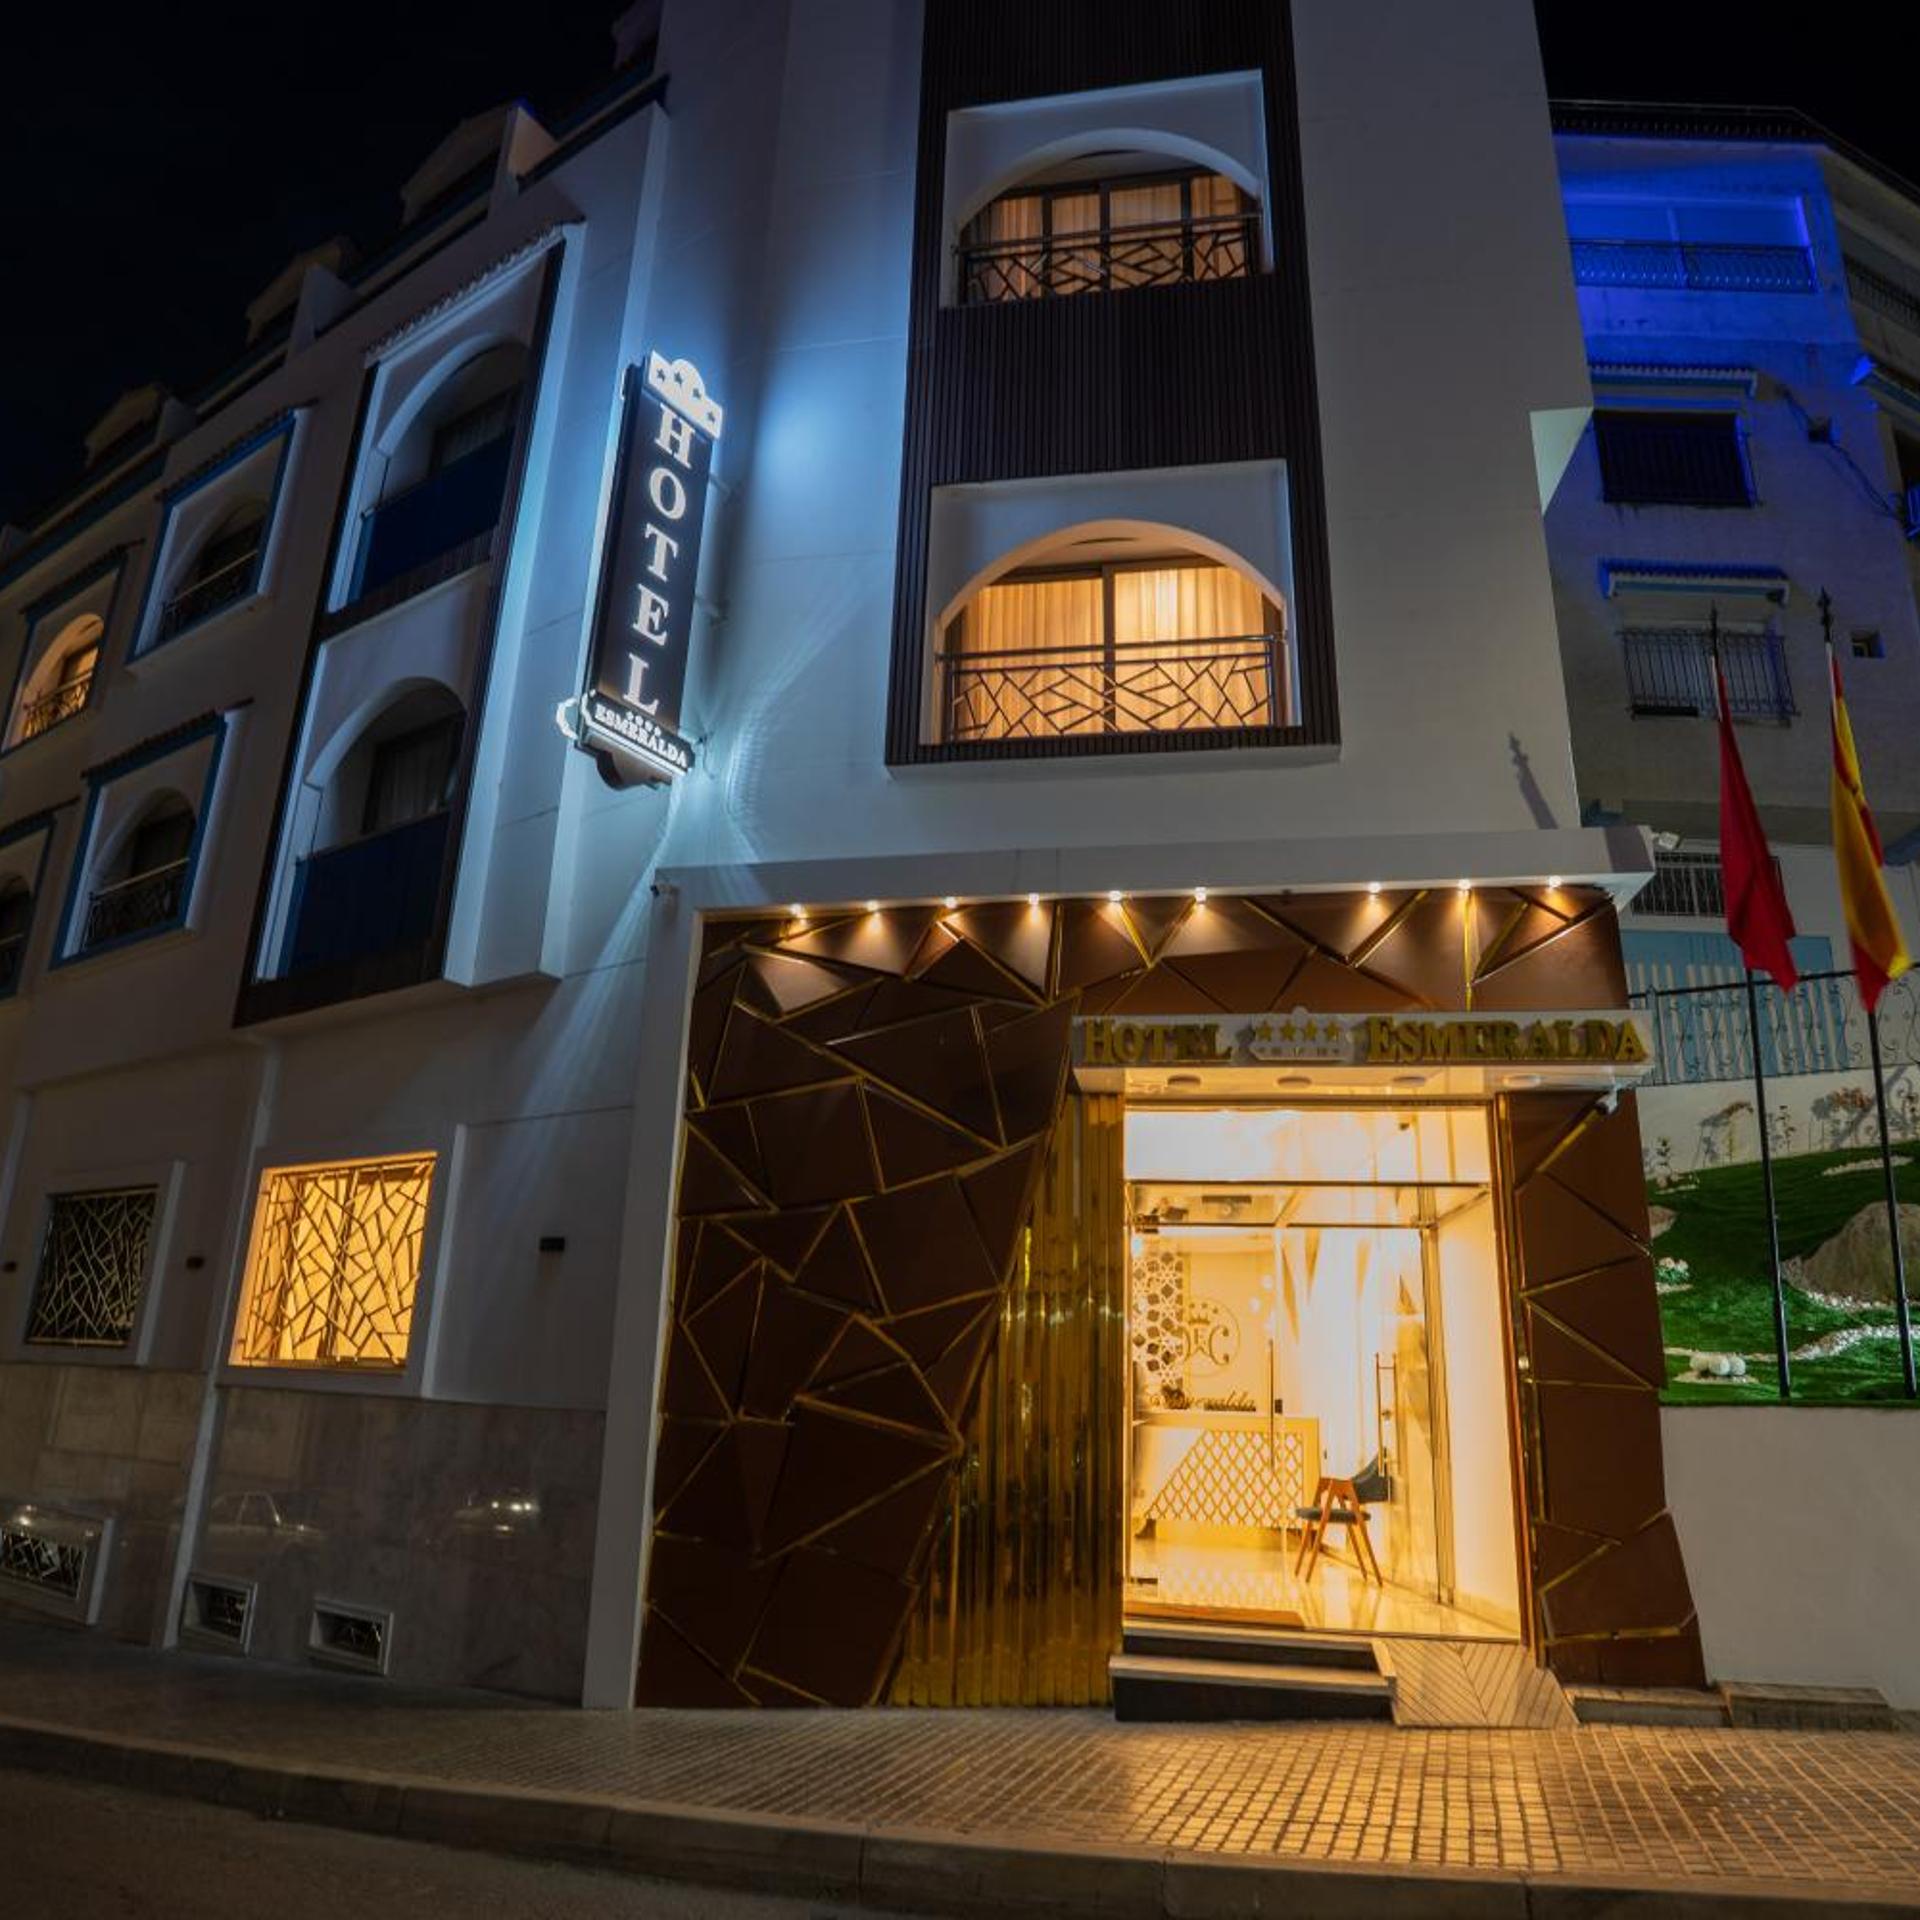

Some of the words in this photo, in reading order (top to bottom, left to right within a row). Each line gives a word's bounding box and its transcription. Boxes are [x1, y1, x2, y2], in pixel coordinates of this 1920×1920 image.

[622, 402, 697, 716] HOTEL
[594, 703, 688, 769] ESMERALDA
[1083, 1016, 1232, 1063] HOTEL
[1366, 1016, 1649, 1063] ESMERALDA
